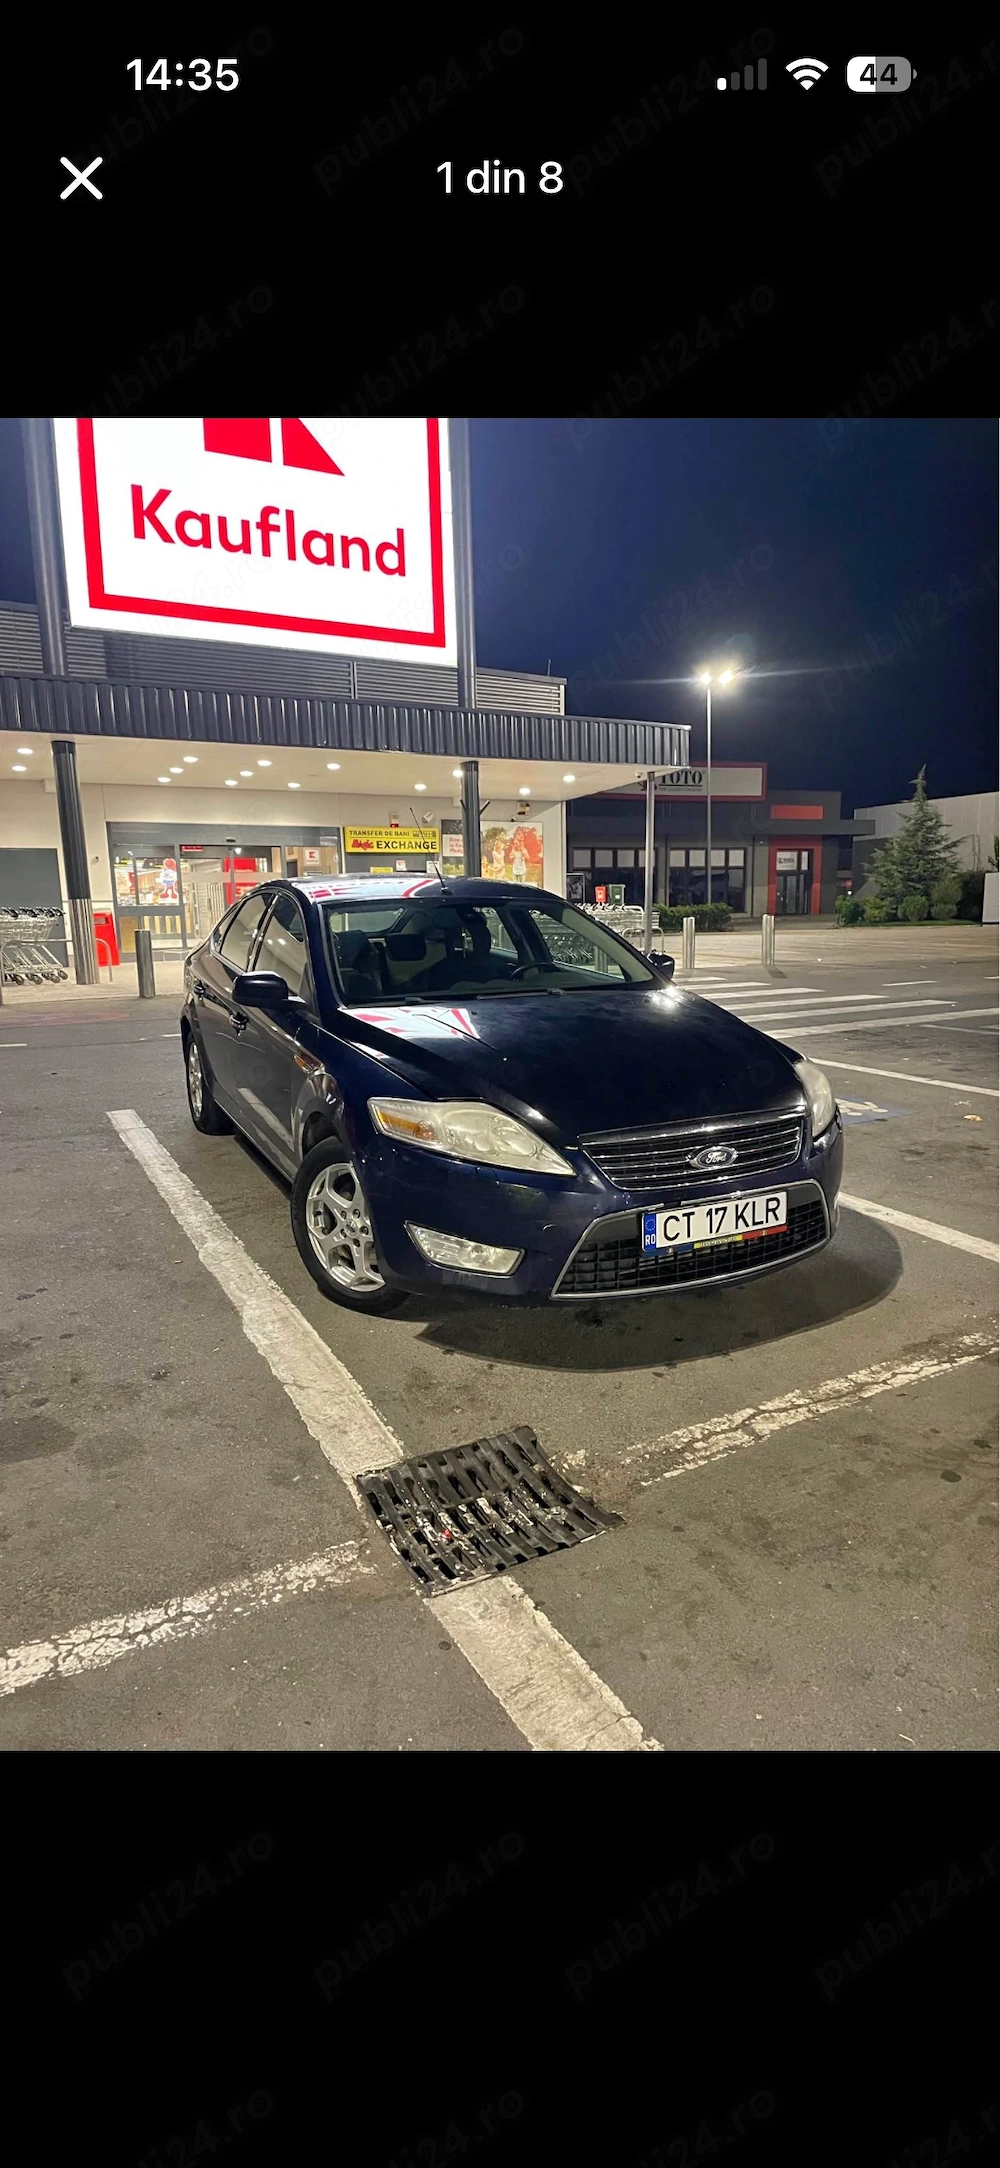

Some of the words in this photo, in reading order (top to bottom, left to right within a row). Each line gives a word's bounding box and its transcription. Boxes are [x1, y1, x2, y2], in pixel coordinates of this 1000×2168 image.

[130, 483, 407, 577] Kaufland
[351, 838, 375, 851] Magic
[376, 840, 437, 850] EXCHANGE
[705, 1151, 727, 1164] Ford
[645, 1233, 656, 1246] RO
[663, 1211, 696, 1242] CT
[706, 1206, 728, 1235] 17
[735, 1197, 781, 1230] KLR
